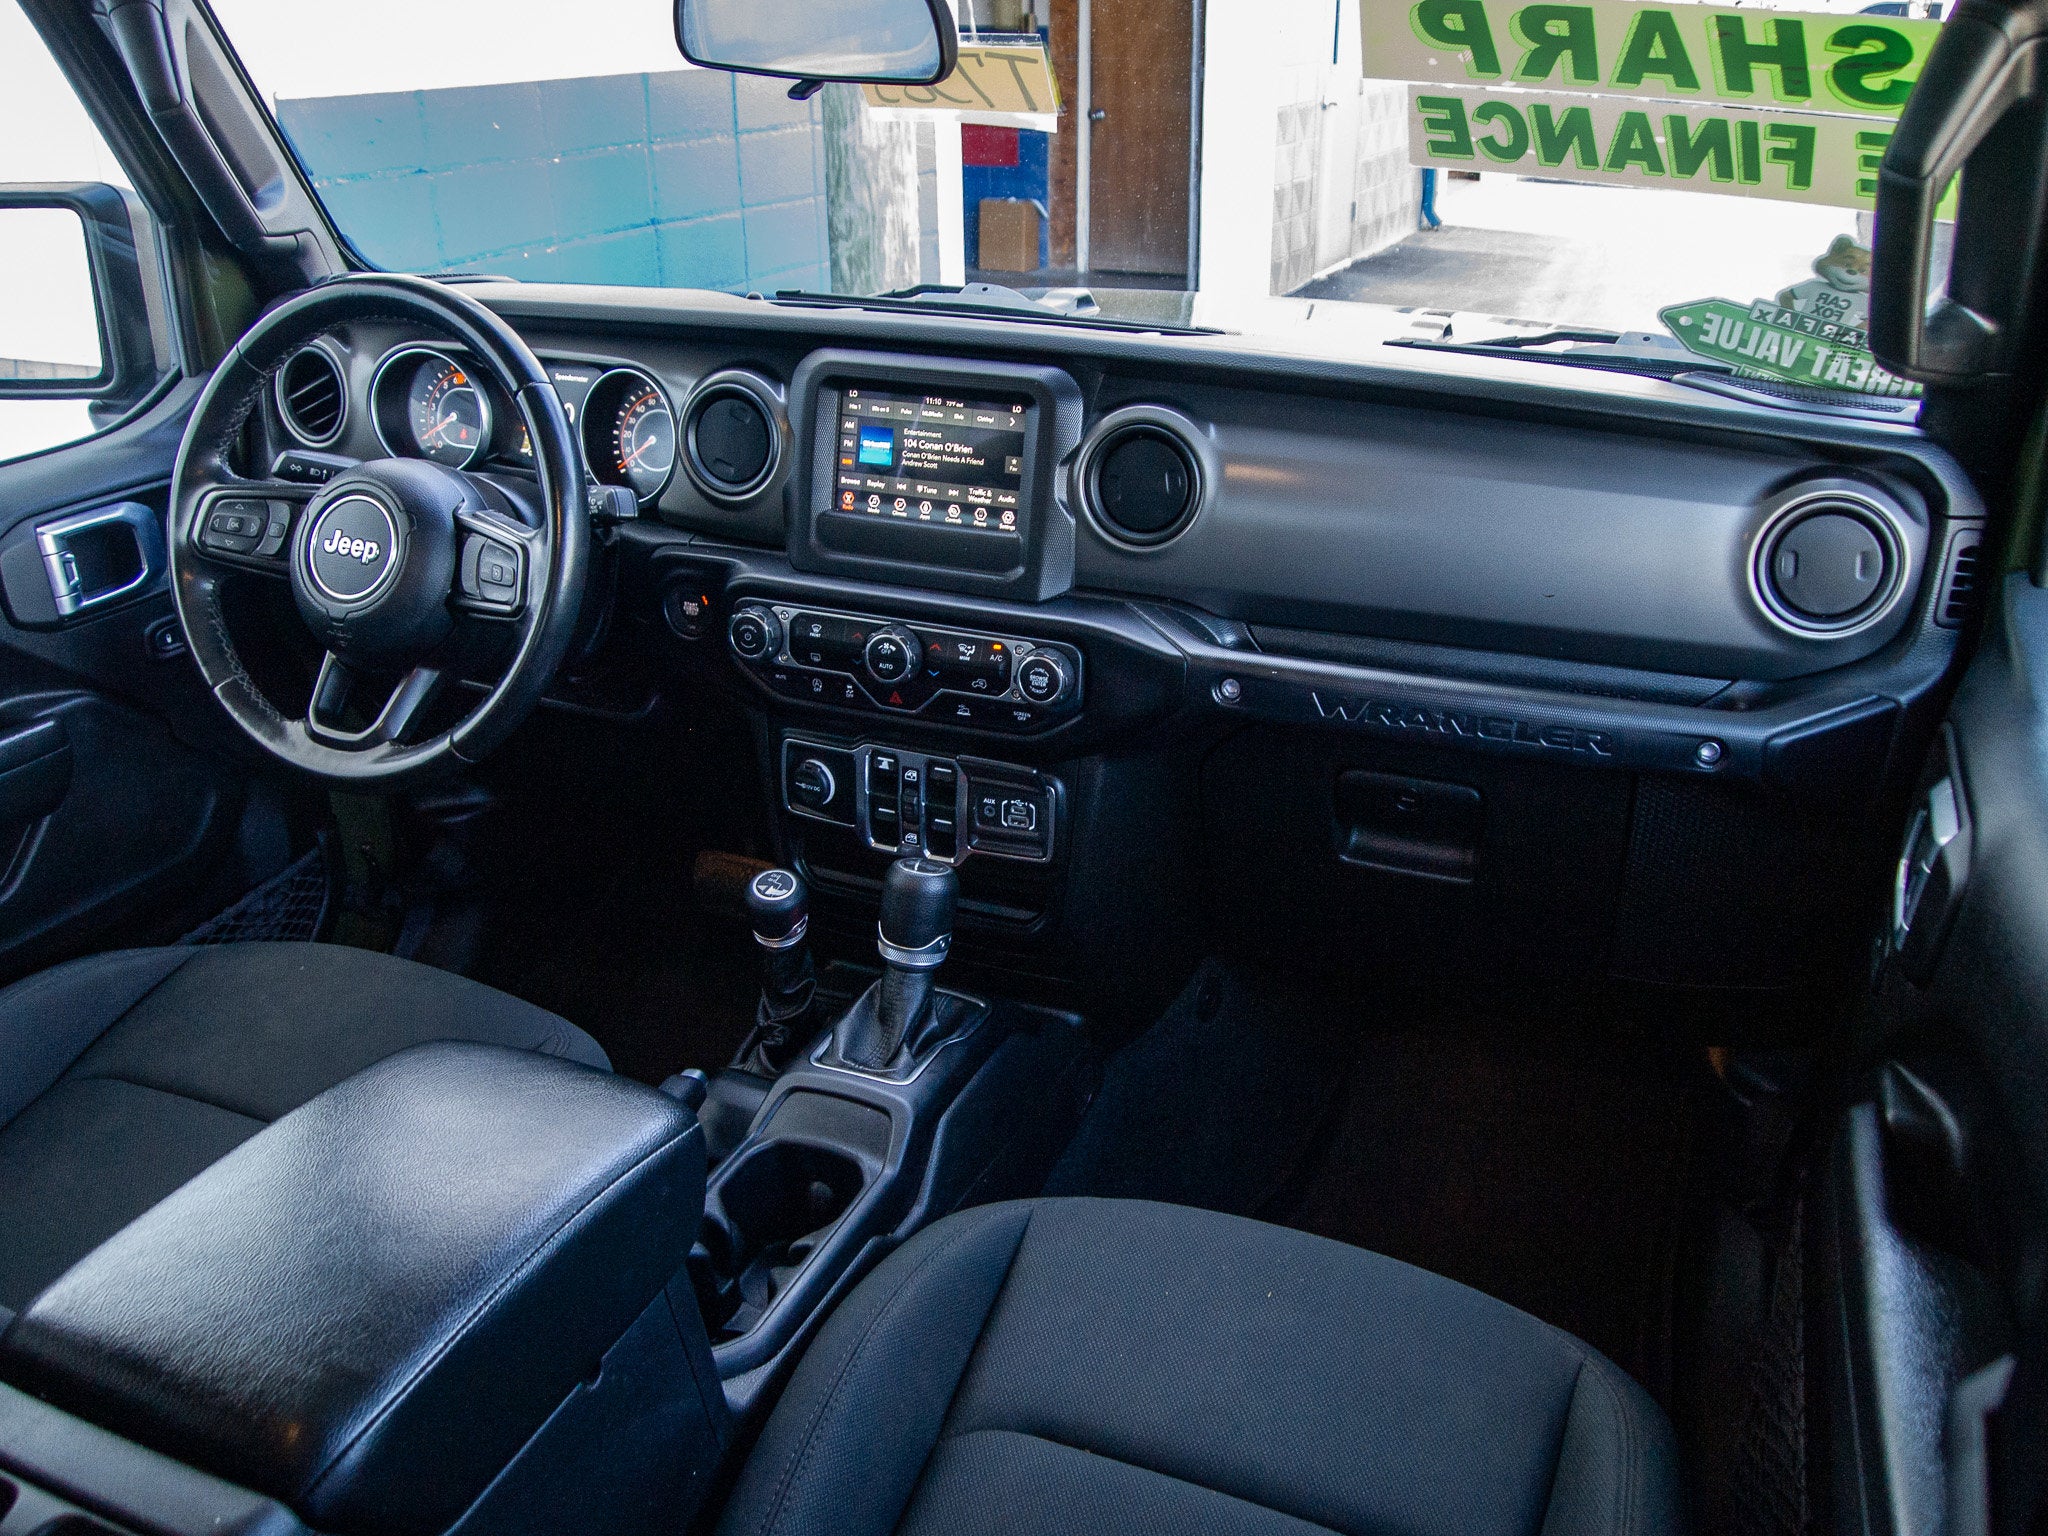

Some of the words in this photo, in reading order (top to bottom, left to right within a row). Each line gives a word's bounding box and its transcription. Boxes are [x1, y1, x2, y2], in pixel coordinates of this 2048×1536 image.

[555, 372, 588, 383] Speedometer
[849, 390, 858, 398] LO
[925, 397, 942, 405] 11:10
[1012, 405, 1022, 413] LO
[844, 421, 855, 429] AM
[903, 428, 941, 438] Entertainment
[843, 439, 853, 447] FM
[903, 438, 917, 448] 104
[918, 440, 943, 451] Conan
[945, 442, 973, 454] O'Brien
[902, 451, 920, 459] Conan
[921, 453, 941, 462] O'Brien
[943, 455, 960, 463] Needs
[967, 457, 985, 466] Friend
[901, 459, 922, 468] Andrew
[923, 461, 938, 469] Scott
[840, 476, 860, 485] Browse
[866, 479, 885, 489] Replay
[923, 486, 937, 495] Tune
[969, 488, 985, 497] Traffic
[968, 495, 992, 504] Weather
[998, 495, 1016, 504] Audio
[323, 529, 380, 565] Jeep
[989, 654, 1003, 662] A/C
[1013, 711, 1032, 719] SCREEN
[1312, 691, 1612, 756] WRANGLER
